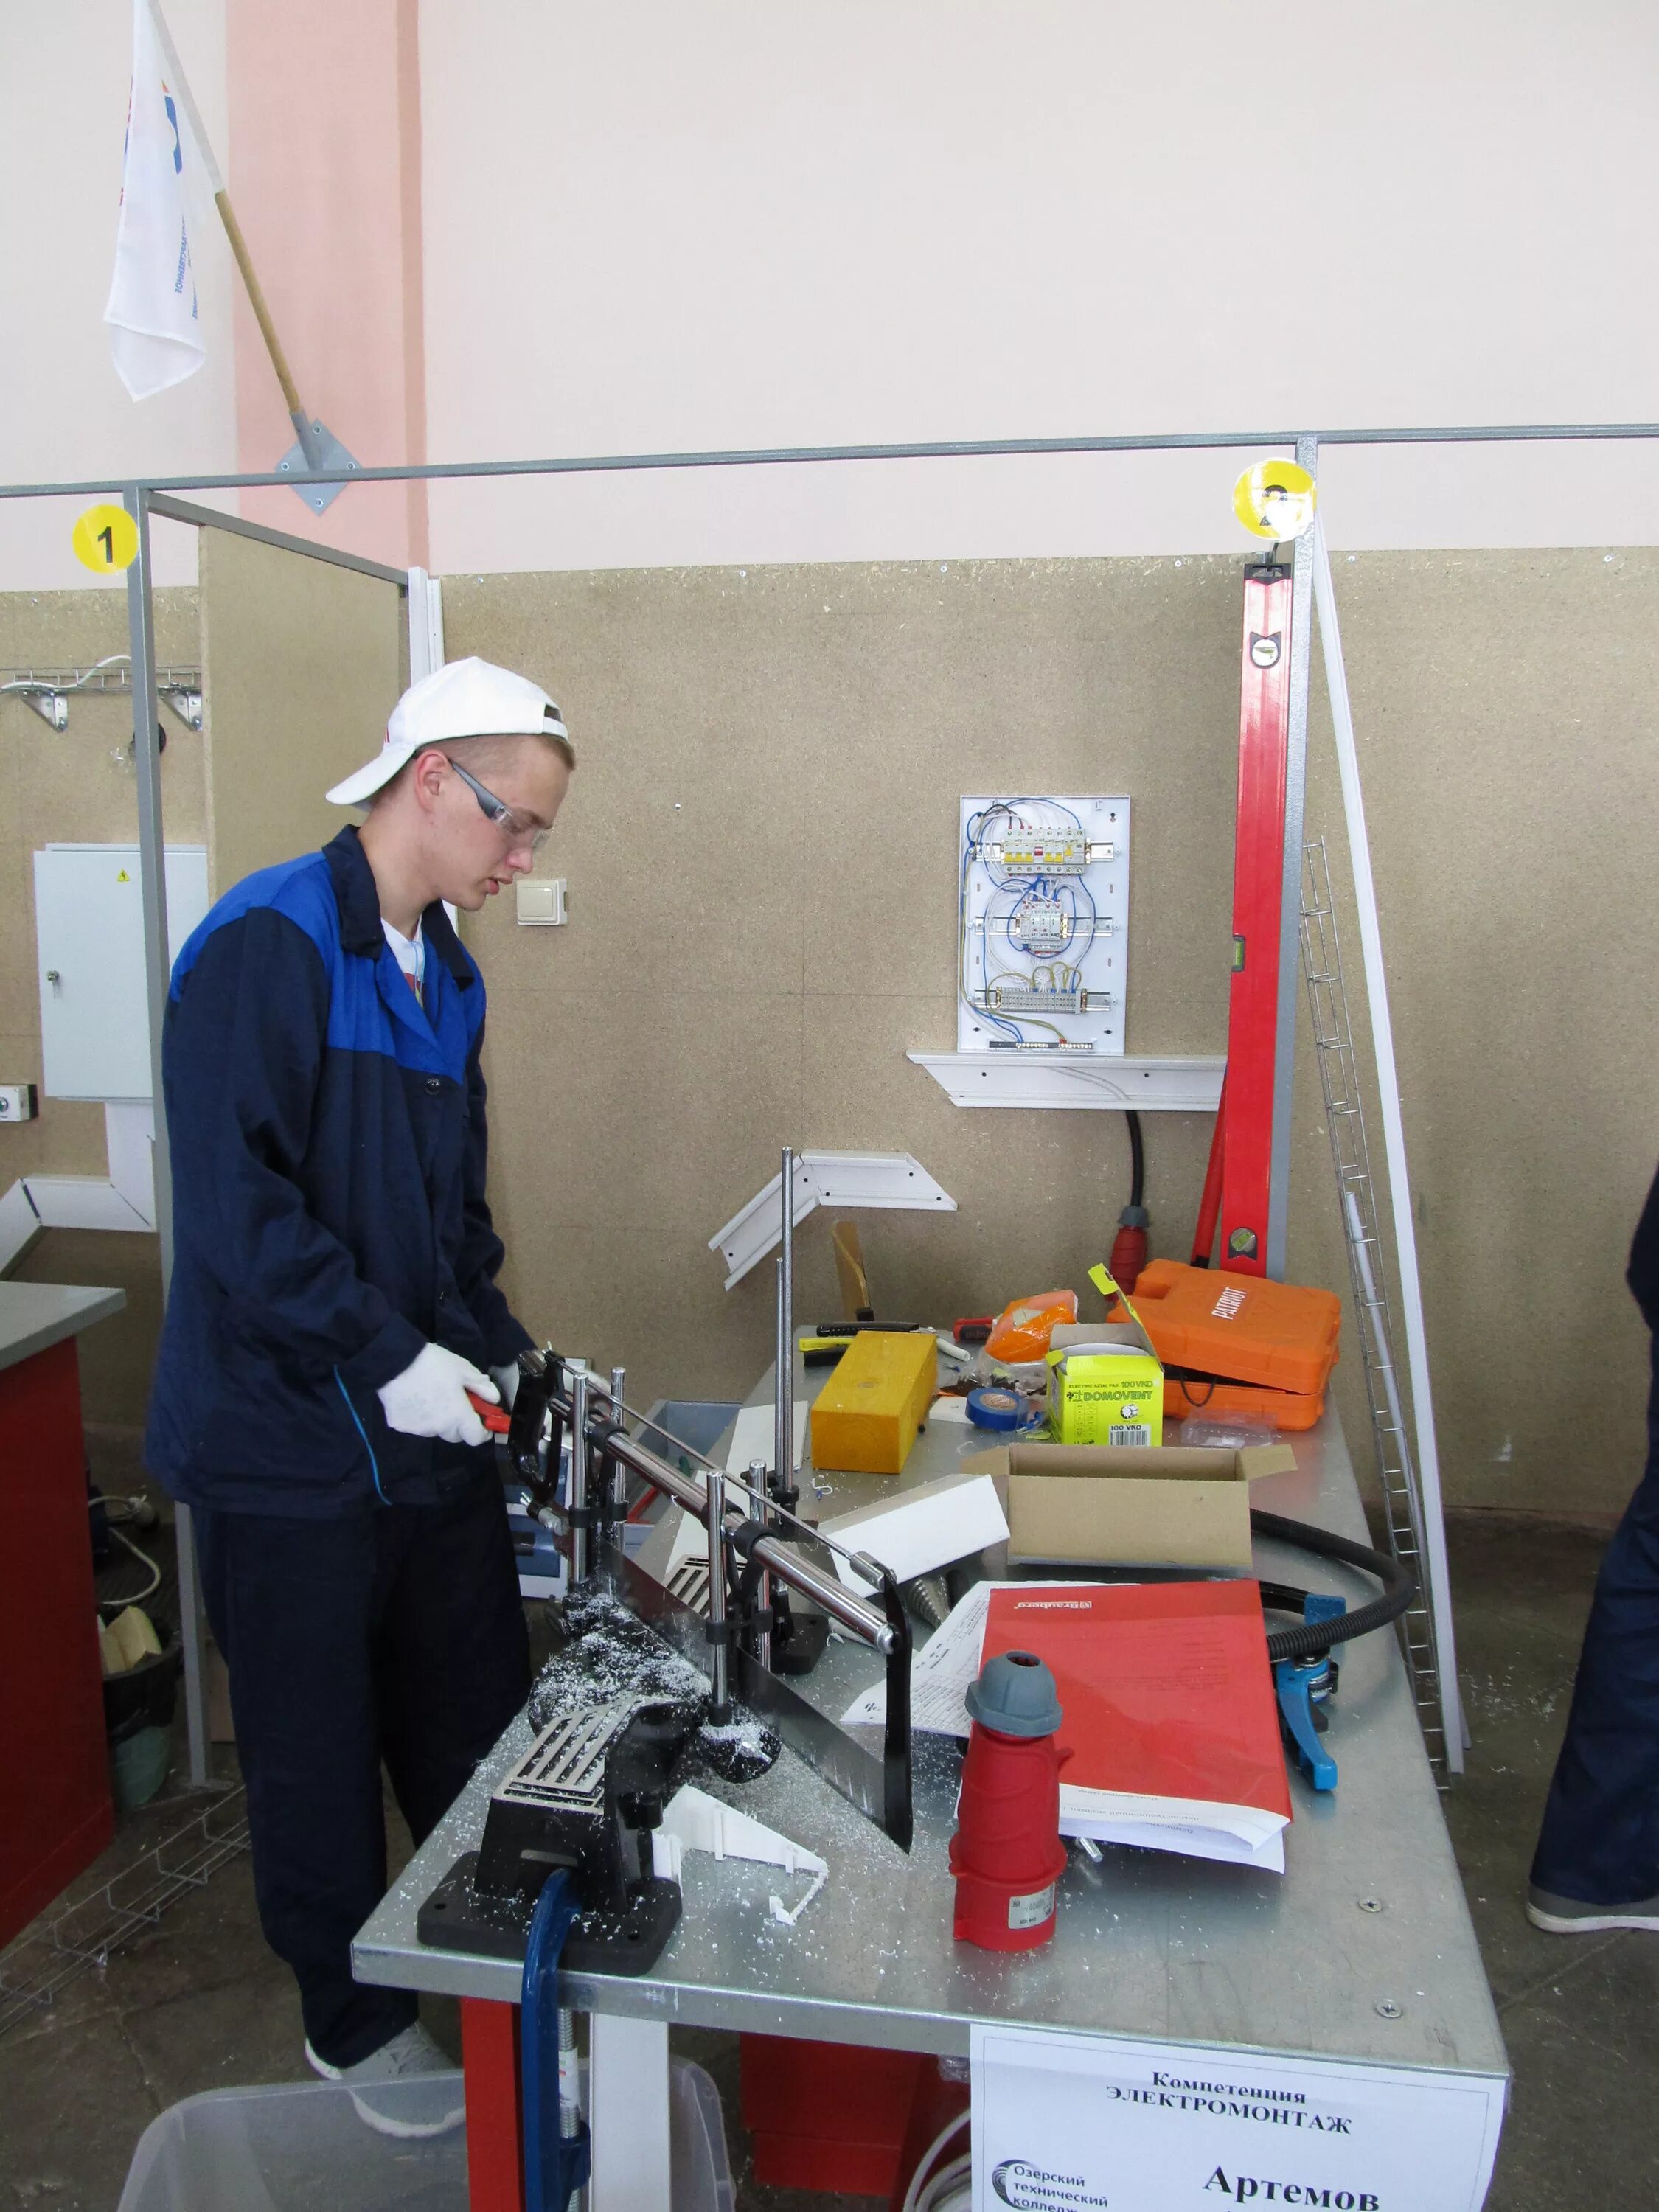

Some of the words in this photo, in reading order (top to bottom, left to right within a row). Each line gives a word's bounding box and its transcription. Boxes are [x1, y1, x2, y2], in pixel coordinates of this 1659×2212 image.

[97, 526, 113, 563] 1
[1211, 1287, 1248, 1320] PATRIOT
[1083, 1390, 1152, 1401] DOMOVENT
[1018, 1601, 1079, 1609] Brauberg
[1152, 2070, 1306, 2104] Компетенция
[1106, 2085, 1352, 2135] ЭЛЕКТРОМОНТАЖ
[1014, 2165, 1085, 2188] Озерский
[1203, 2165, 1380, 2212] Артемов
[1013, 2182, 1109, 2208] технический
